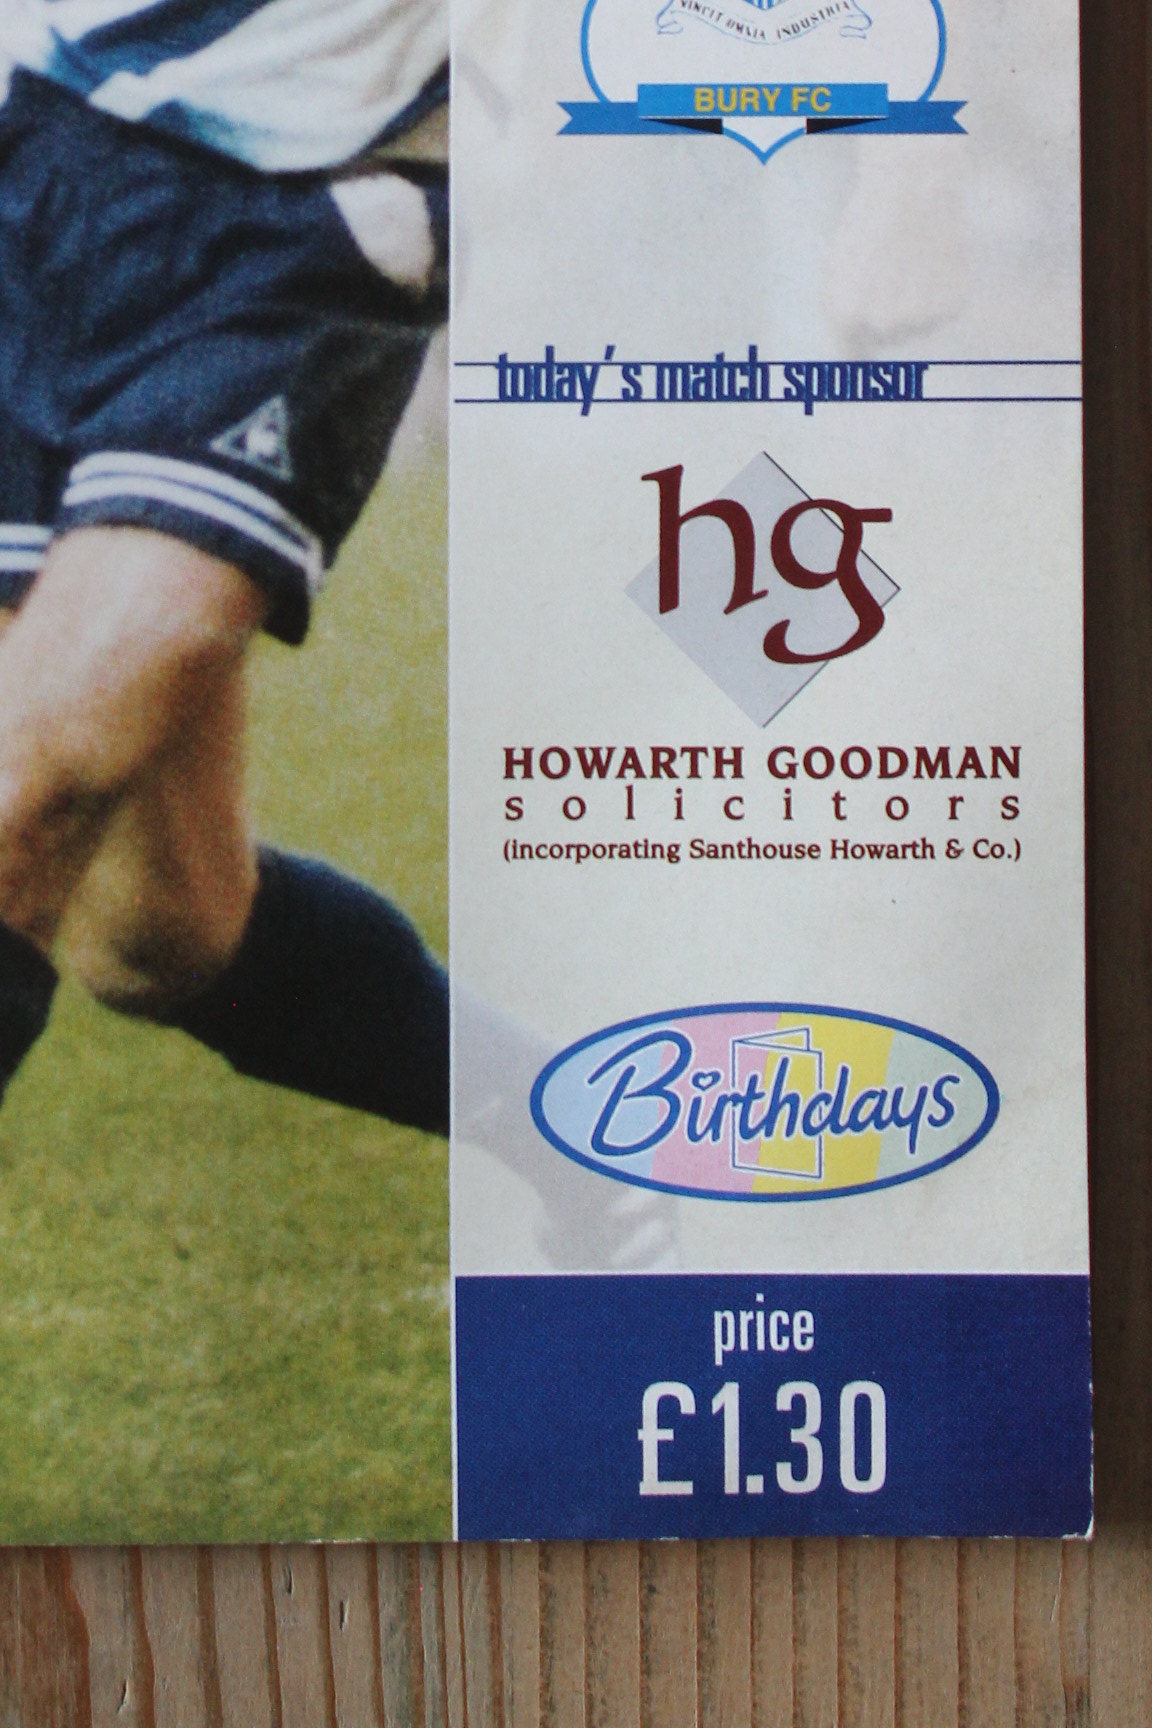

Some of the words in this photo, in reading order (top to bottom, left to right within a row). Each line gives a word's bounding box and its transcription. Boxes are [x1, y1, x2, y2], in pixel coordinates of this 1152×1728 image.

[693, 86, 782, 114] BURY
[790, 86, 832, 114] FC
[495, 344, 643, 416] today's
[655, 344, 770, 402] match
[783, 361, 930, 416] sponsor
[641, 463, 893, 665] hg
[502, 746, 745, 780] HOWARTH
[766, 745, 1023, 780] GOODMAN
[504, 785, 1021, 822] solicitors
[502, 837, 681, 864] (incorporating
[689, 838, 822, 861] Santhouse
[829, 838, 936, 861] Howarth
[945, 838, 965, 861] &
[971, 837, 1023, 863] Co.)
[586, 1029, 962, 1157] Birthdays
[713, 1292, 816, 1367] price
[637, 1380, 888, 1497] £1.30
